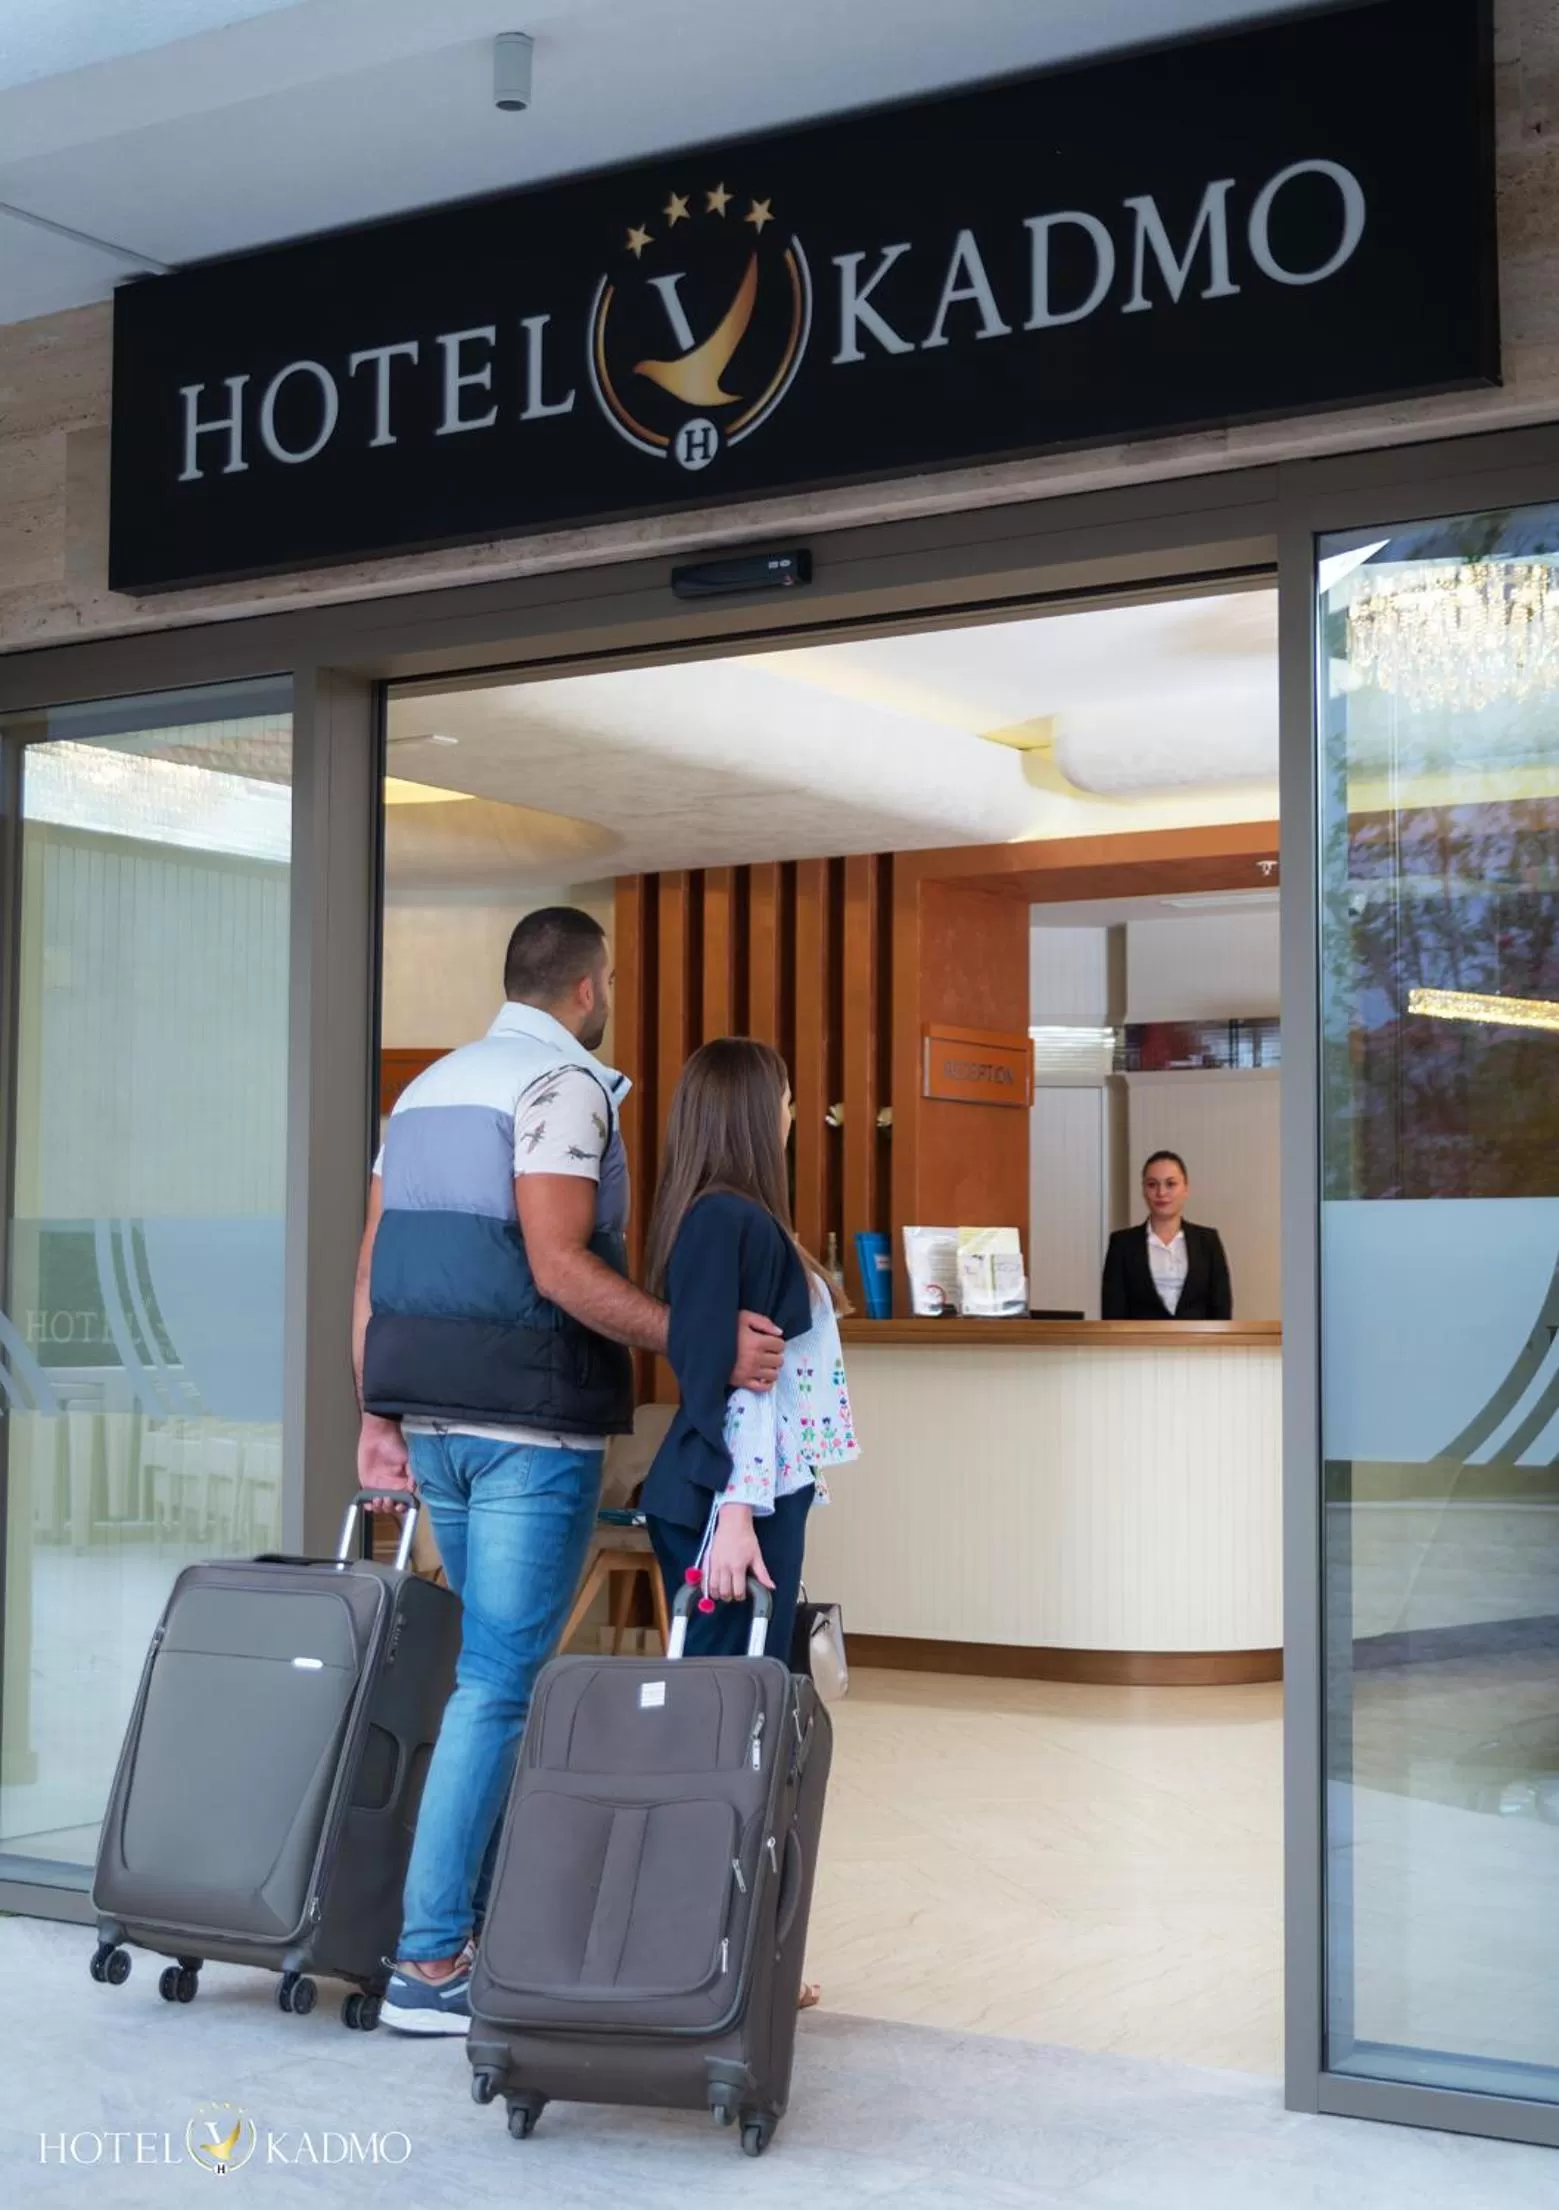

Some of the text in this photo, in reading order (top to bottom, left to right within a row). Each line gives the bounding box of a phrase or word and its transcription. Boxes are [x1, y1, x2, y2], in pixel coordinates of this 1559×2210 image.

[178, 314, 577, 483] HOTEL
[831, 159, 1366, 365] KADMO
[683, 425, 712, 463] H
[943, 1061, 1014, 1086] EPTION
